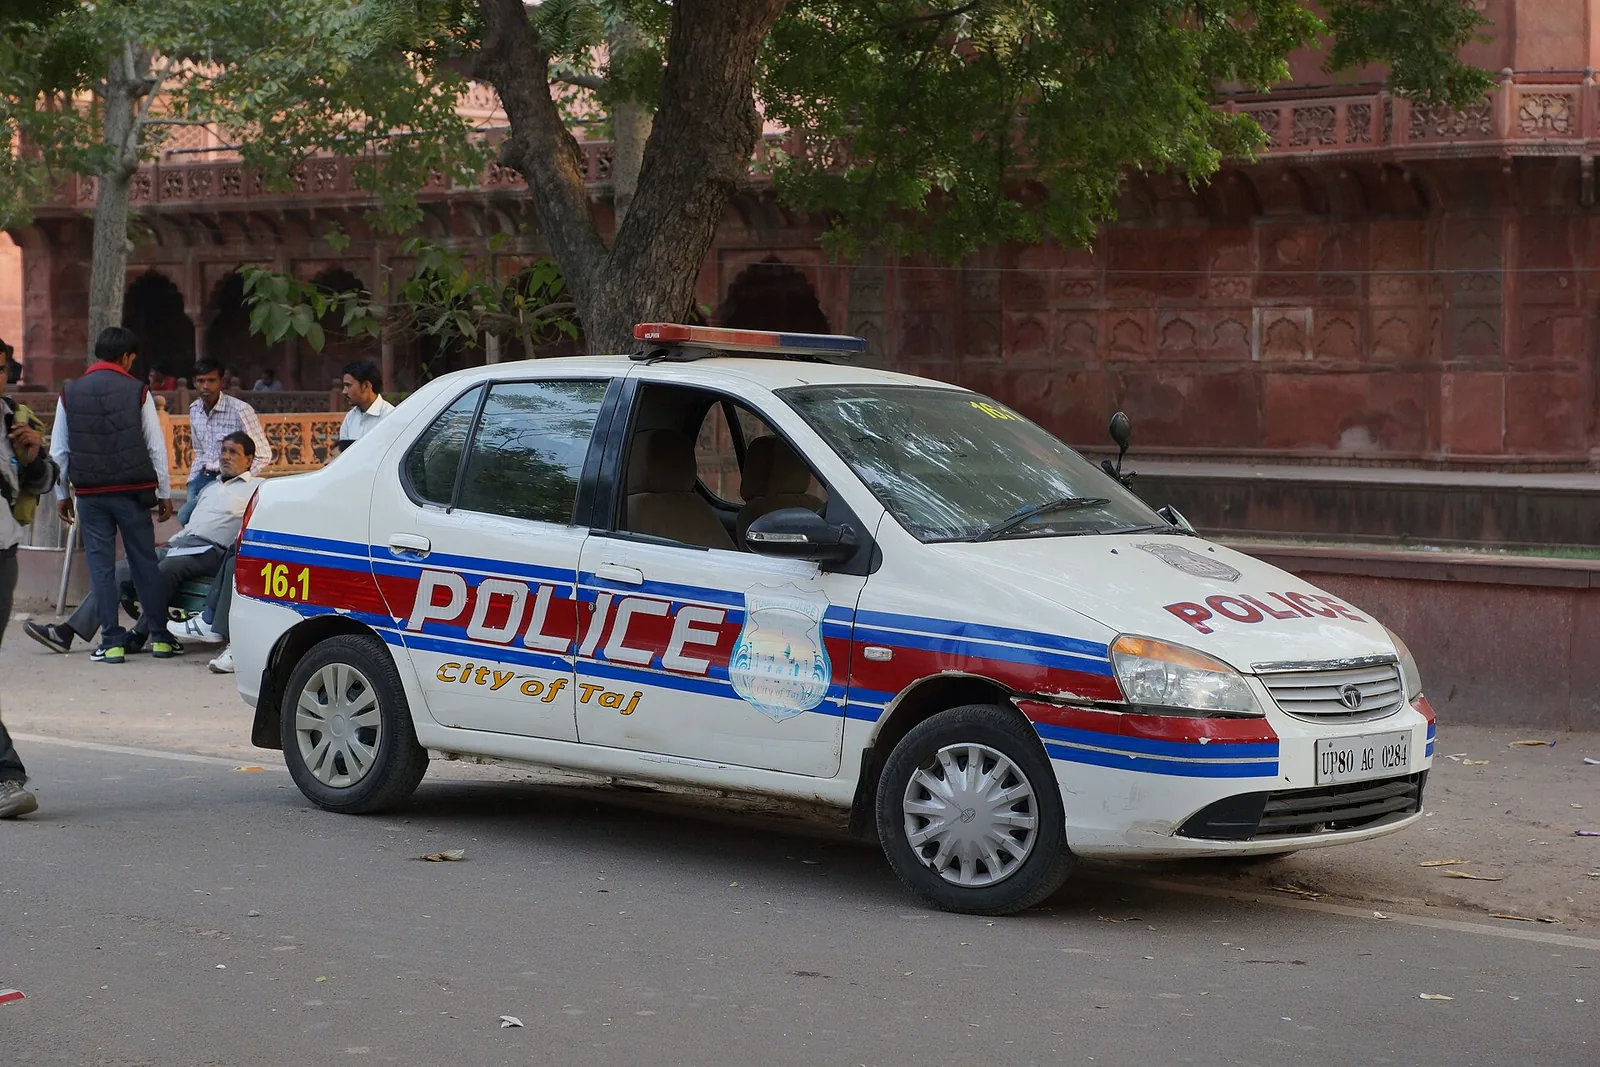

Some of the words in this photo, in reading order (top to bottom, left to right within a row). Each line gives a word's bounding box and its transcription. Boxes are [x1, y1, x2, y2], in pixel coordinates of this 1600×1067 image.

[260, 562, 310, 601] 16.1
[405, 568, 730, 676] POLICE
[1162, 590, 1369, 635] POLICE
[435, 661, 515, 691] City
[519, 678, 569, 703] of
[578, 682, 644, 716] Taj
[756, 685, 774, 698] City
[1322, 749, 1355, 776] UP80
[1360, 747, 1375, 772] AG
[1381, 743, 1408, 769] 0284
